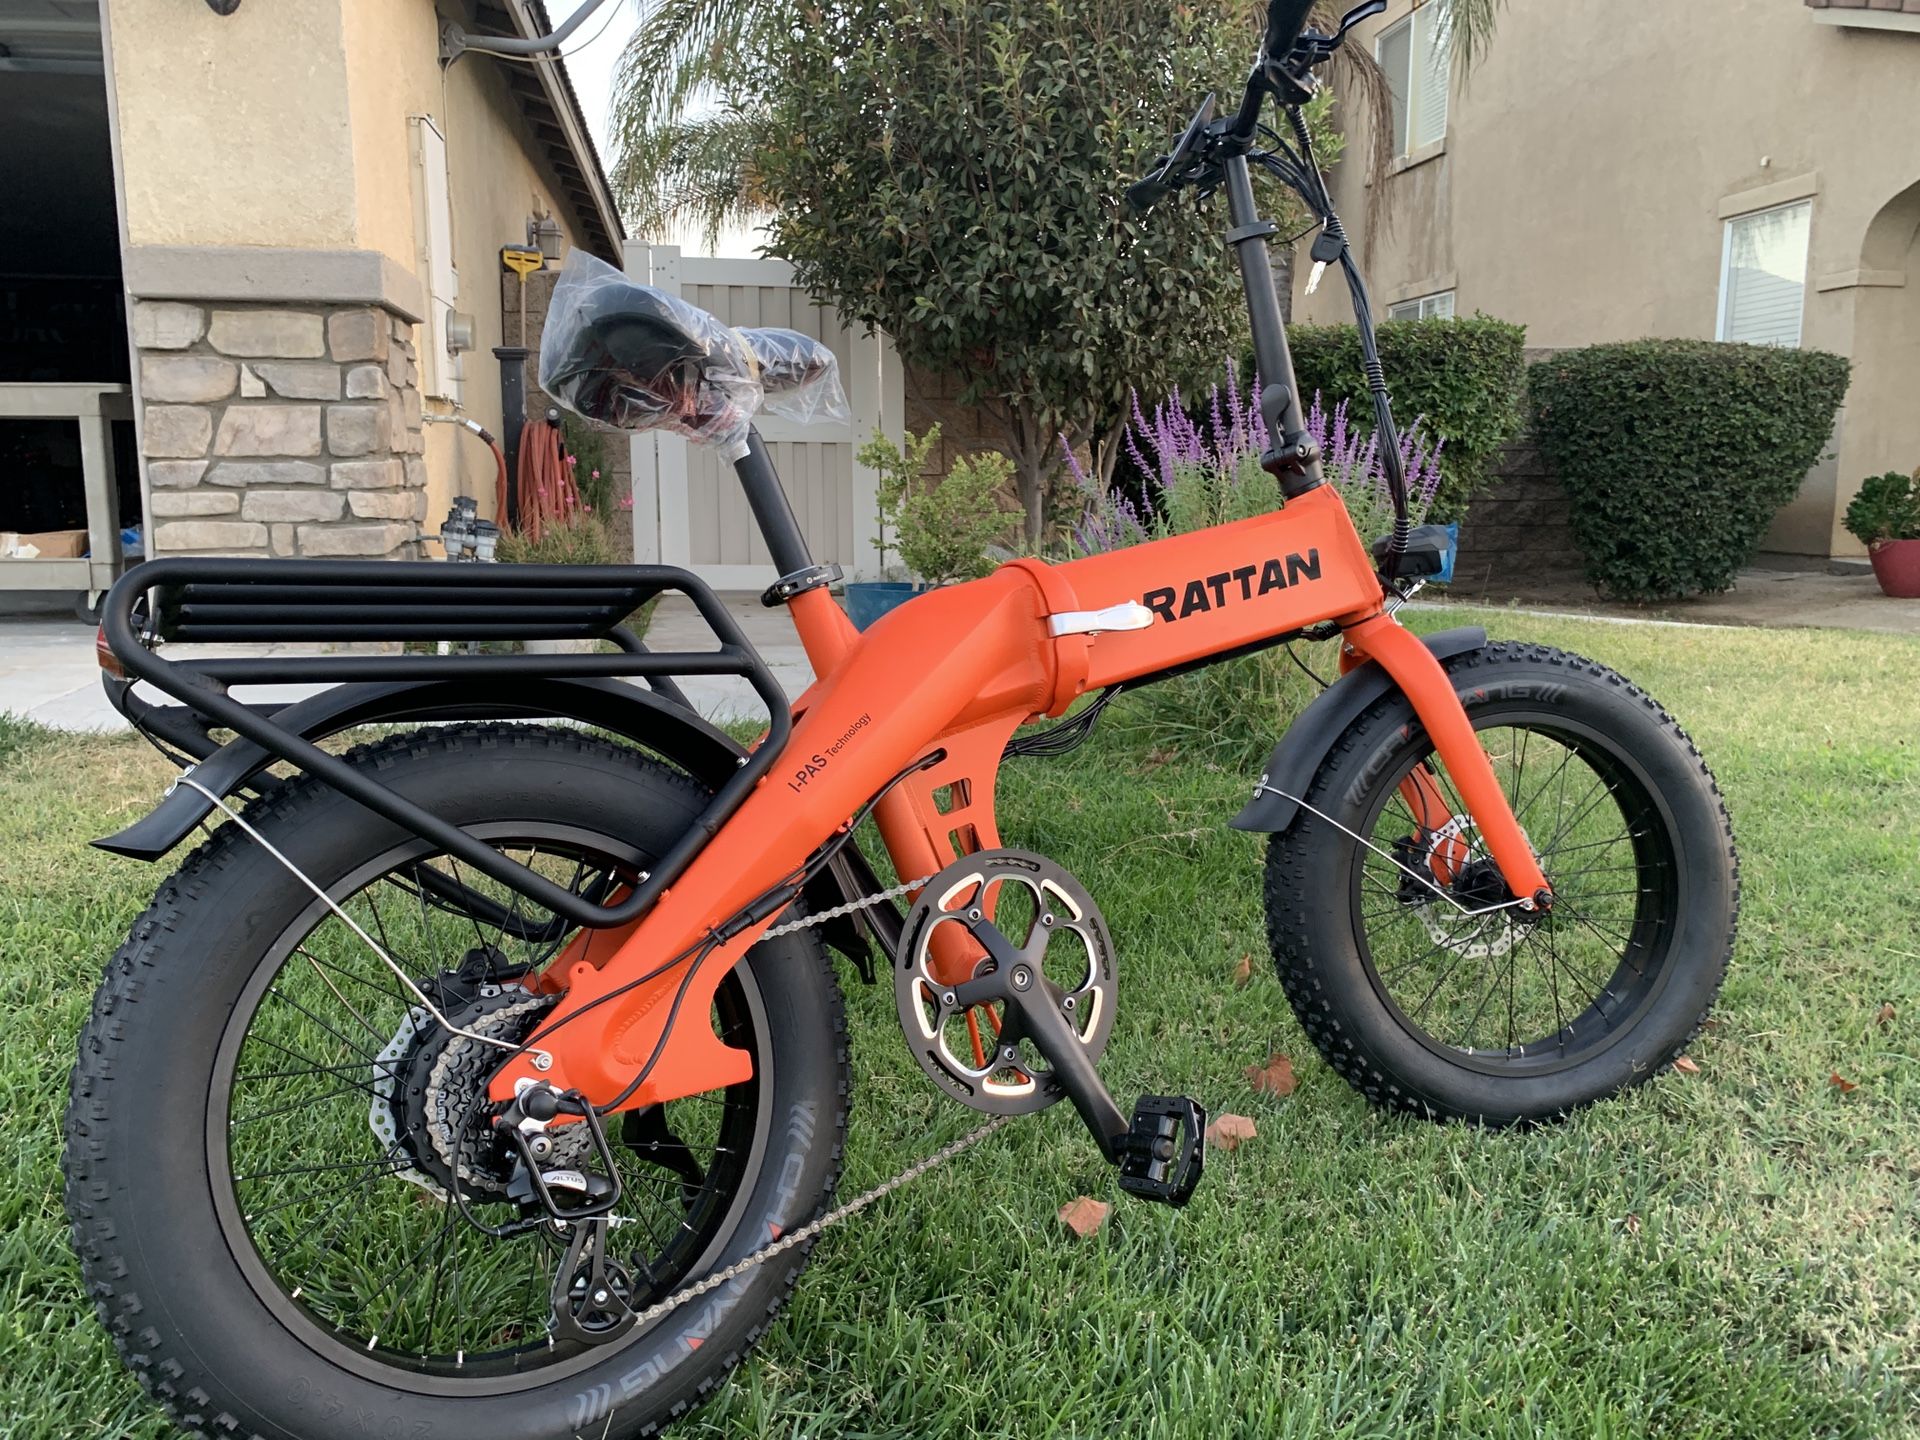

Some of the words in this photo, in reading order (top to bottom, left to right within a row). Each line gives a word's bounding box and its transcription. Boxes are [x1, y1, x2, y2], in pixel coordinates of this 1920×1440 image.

[1143, 547, 1322, 623] RATTAN
[787, 754, 827, 793] I-PAS
[824, 712, 872, 757] Technology
[551, 1175, 583, 1184] ALTUS
